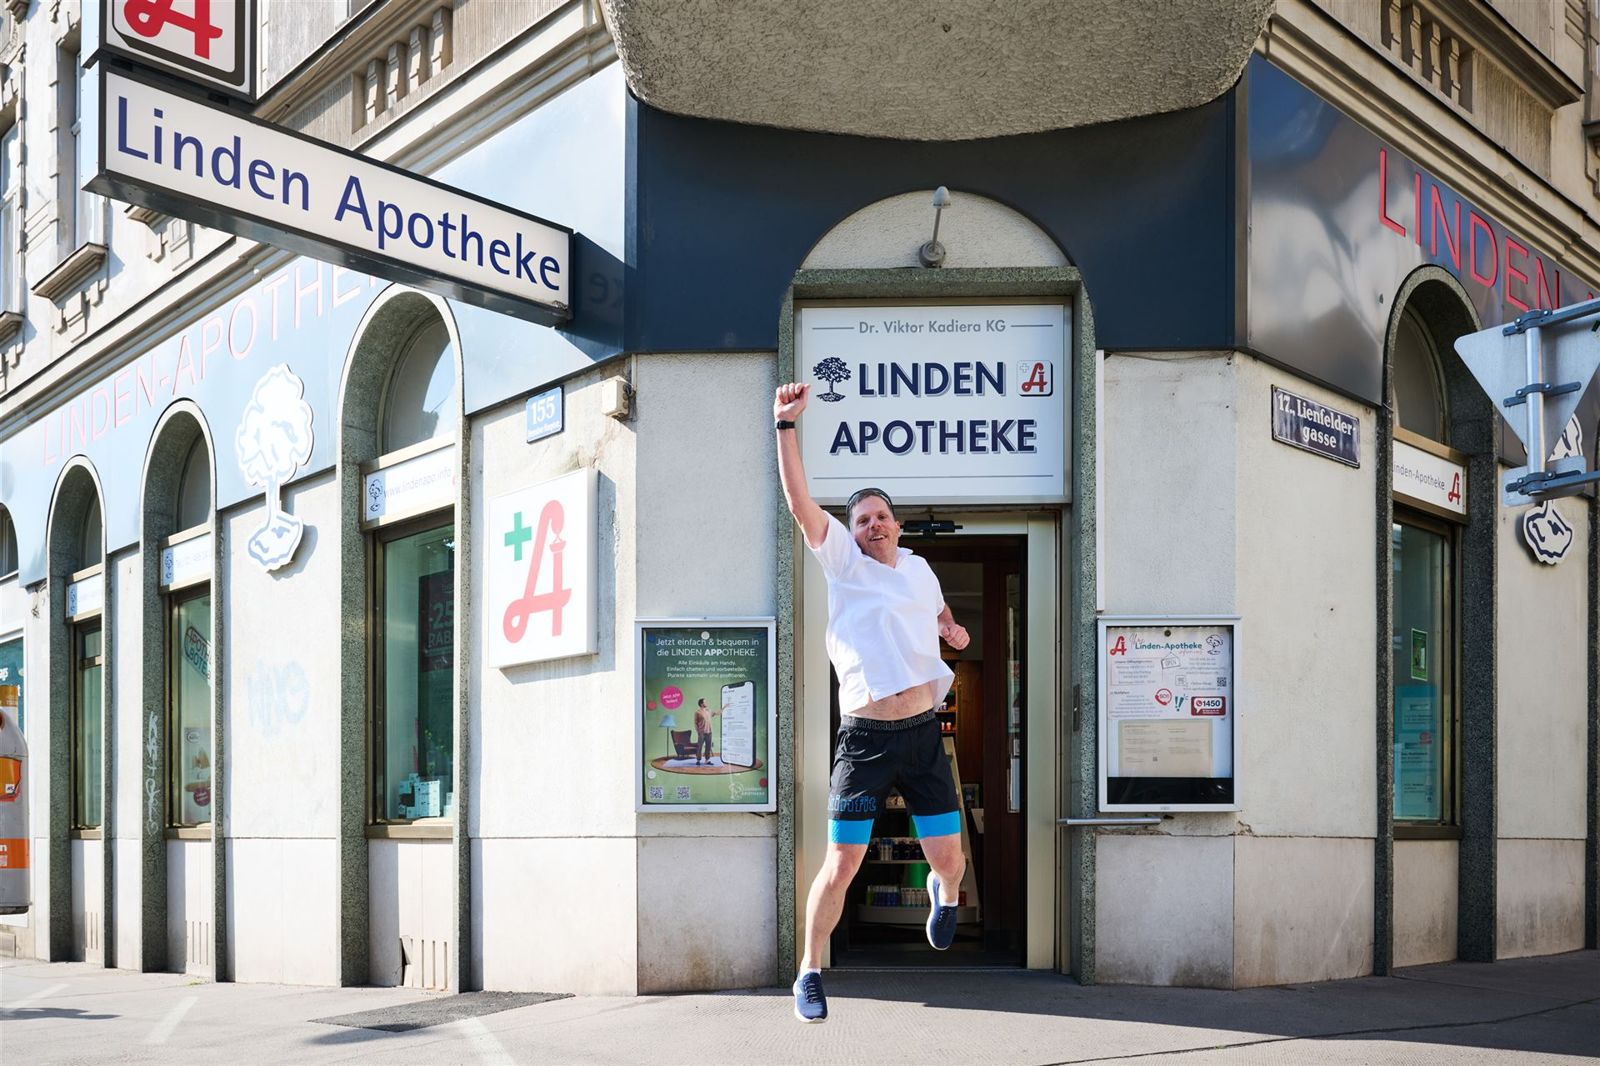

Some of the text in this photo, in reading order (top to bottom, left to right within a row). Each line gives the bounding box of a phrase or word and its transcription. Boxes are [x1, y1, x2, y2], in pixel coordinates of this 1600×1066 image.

[116, 95, 561, 291] Linden Apotheke
[859, 319, 1006, 334] Dr. Viktor Kadiera KG
[43, 257, 377, 466] LINDEN-APOTHE
[859, 361, 1004, 396] LINDEN
[531, 395, 556, 425] 155
[829, 419, 1036, 453] APOTHEKE
[1302, 426, 1337, 448] gasse
[678, 638, 706, 646] einfach
[717, 638, 750, 648] bequem
[704, 648, 758, 656] APPOTHEKE.
[1135, 642, 1202, 650] Linden-Apotheke
